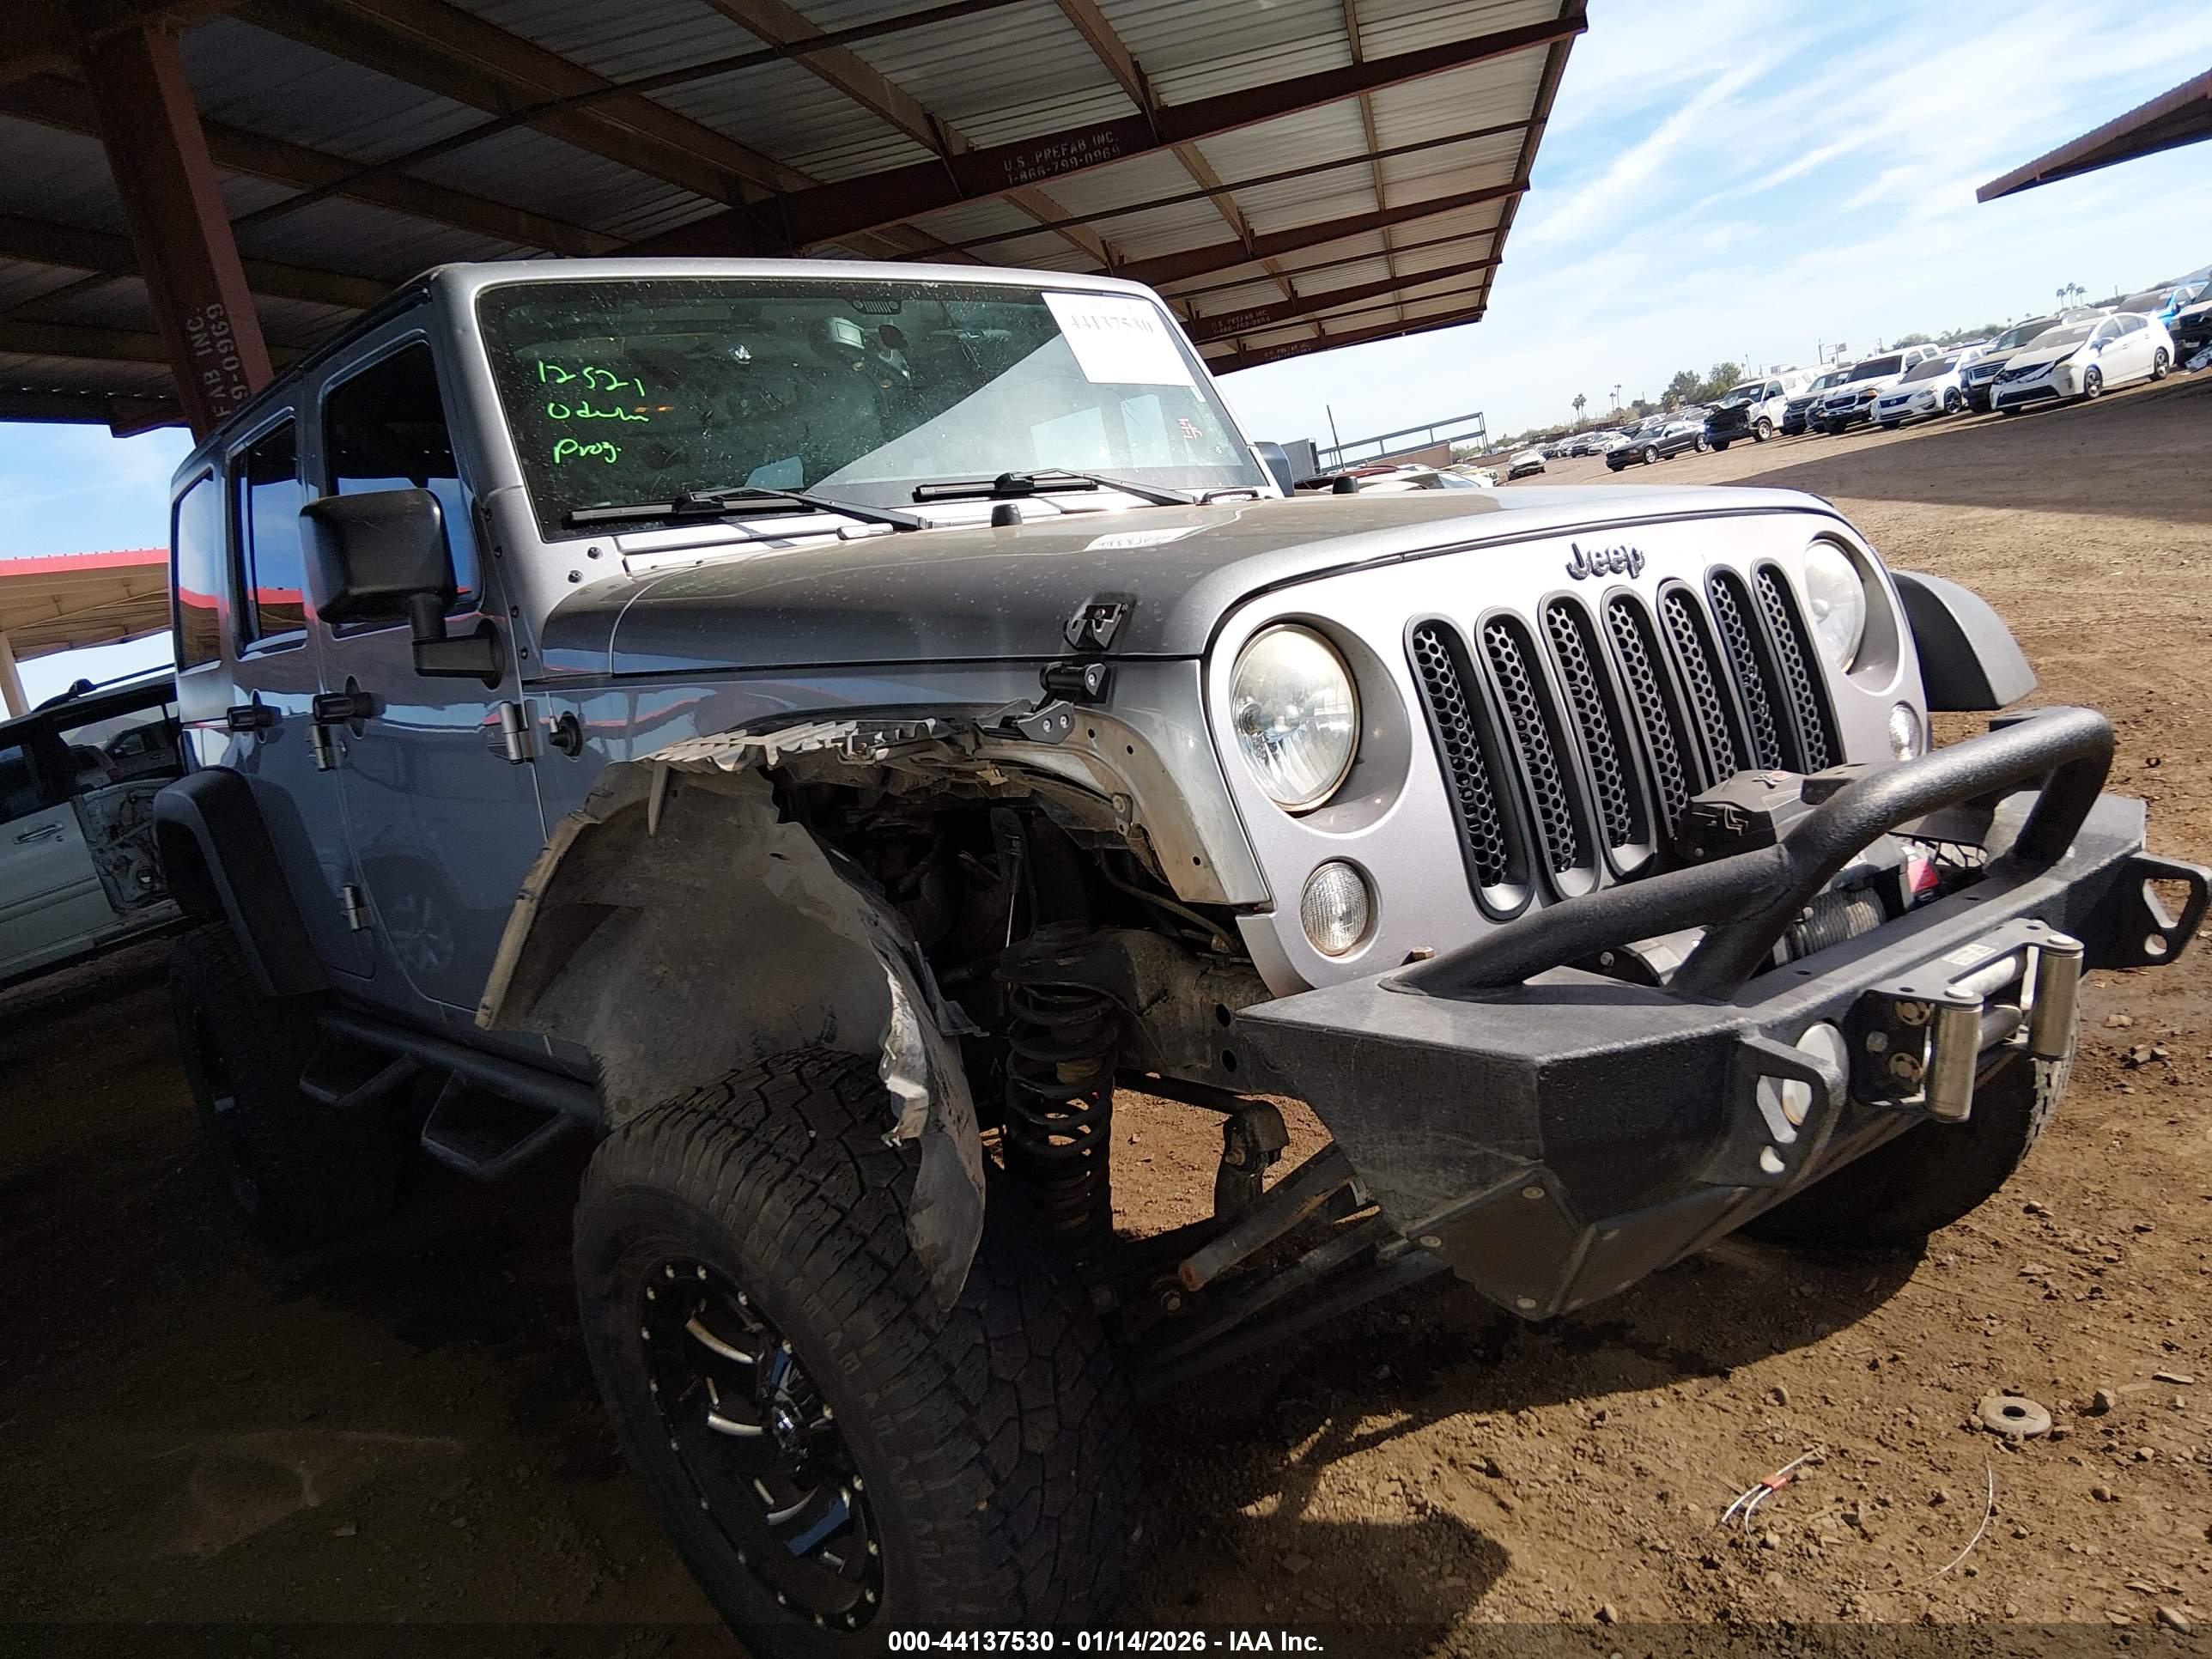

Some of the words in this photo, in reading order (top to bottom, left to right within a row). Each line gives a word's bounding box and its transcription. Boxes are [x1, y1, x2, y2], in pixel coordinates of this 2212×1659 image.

[1036, 139, 1086, 162] PREFAB
[1092, 131, 1119, 145] INC.
[1565, 542, 1645, 580] Jeep
